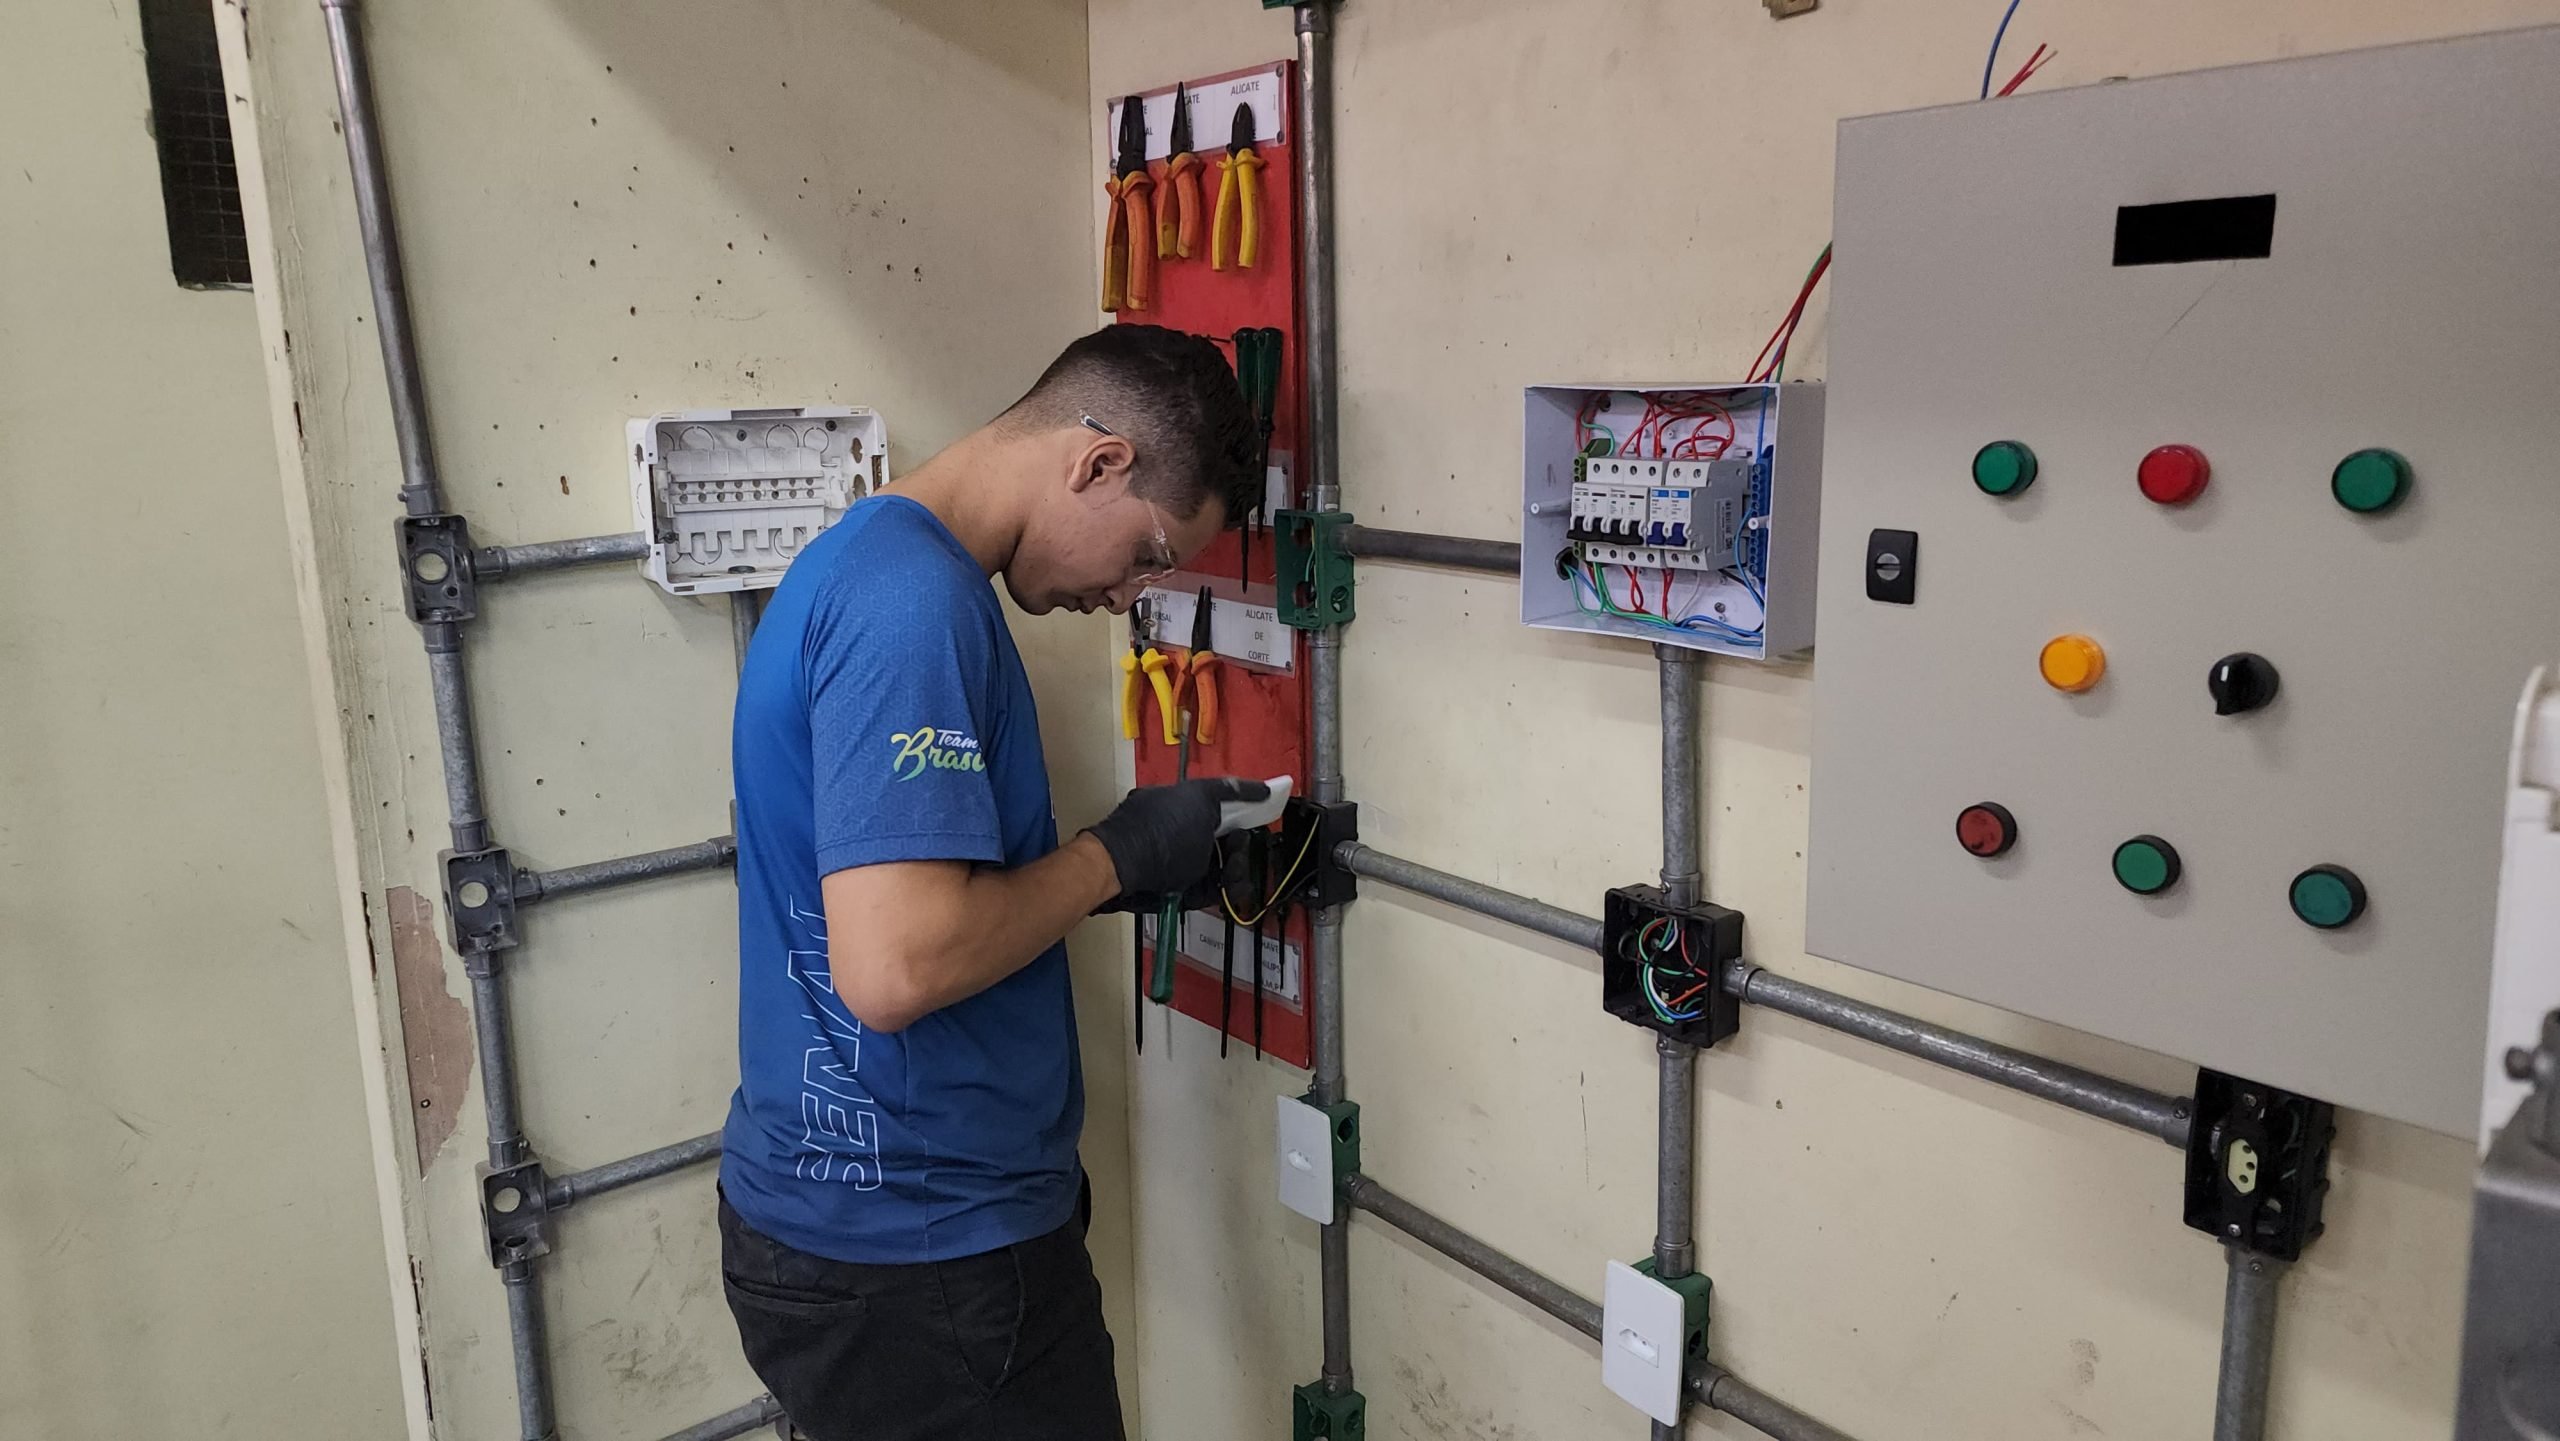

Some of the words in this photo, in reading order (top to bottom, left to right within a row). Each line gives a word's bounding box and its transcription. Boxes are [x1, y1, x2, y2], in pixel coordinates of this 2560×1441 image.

[1230, 80, 1260, 96] ALICATE
[1151, 611, 1172, 623] VERSAL
[1245, 608, 1273, 622] ALICATE
[1254, 631, 1264, 640] DE
[1247, 650, 1270, 663] CORTE
[936, 729, 979, 749] Team
[891, 726, 987, 783] Brasi
